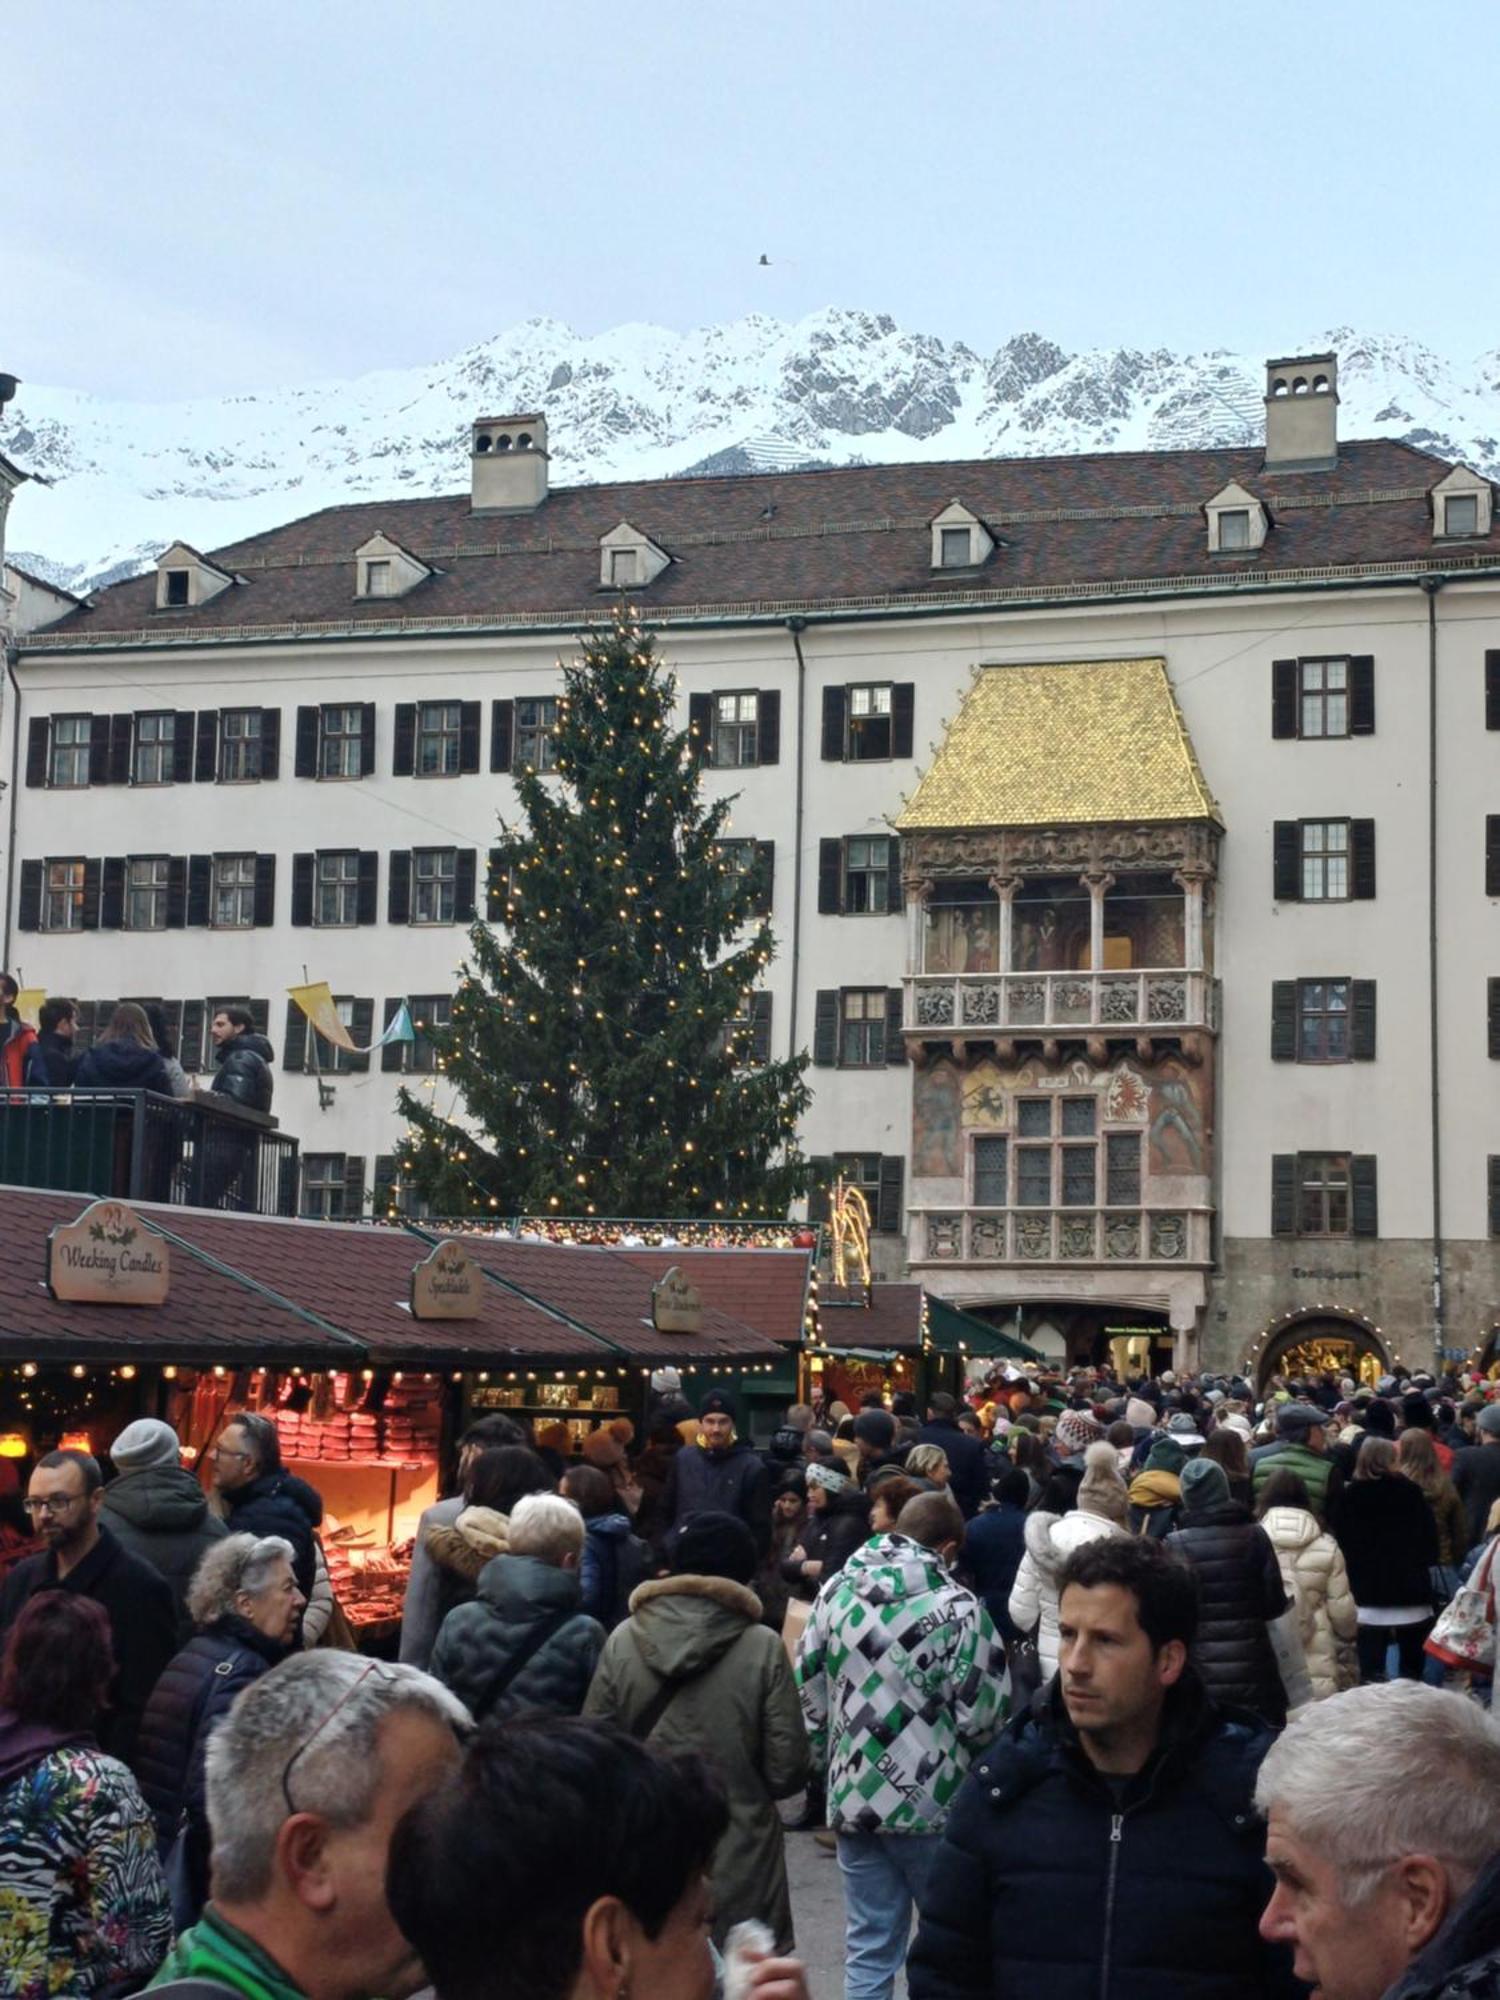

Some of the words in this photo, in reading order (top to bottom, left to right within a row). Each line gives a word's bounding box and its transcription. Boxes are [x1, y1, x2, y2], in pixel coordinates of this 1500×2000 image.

[120, 1250, 162, 1273] Candles
[919, 1603, 957, 1634] BILLA
[875, 1753, 919, 1800] BILLA
